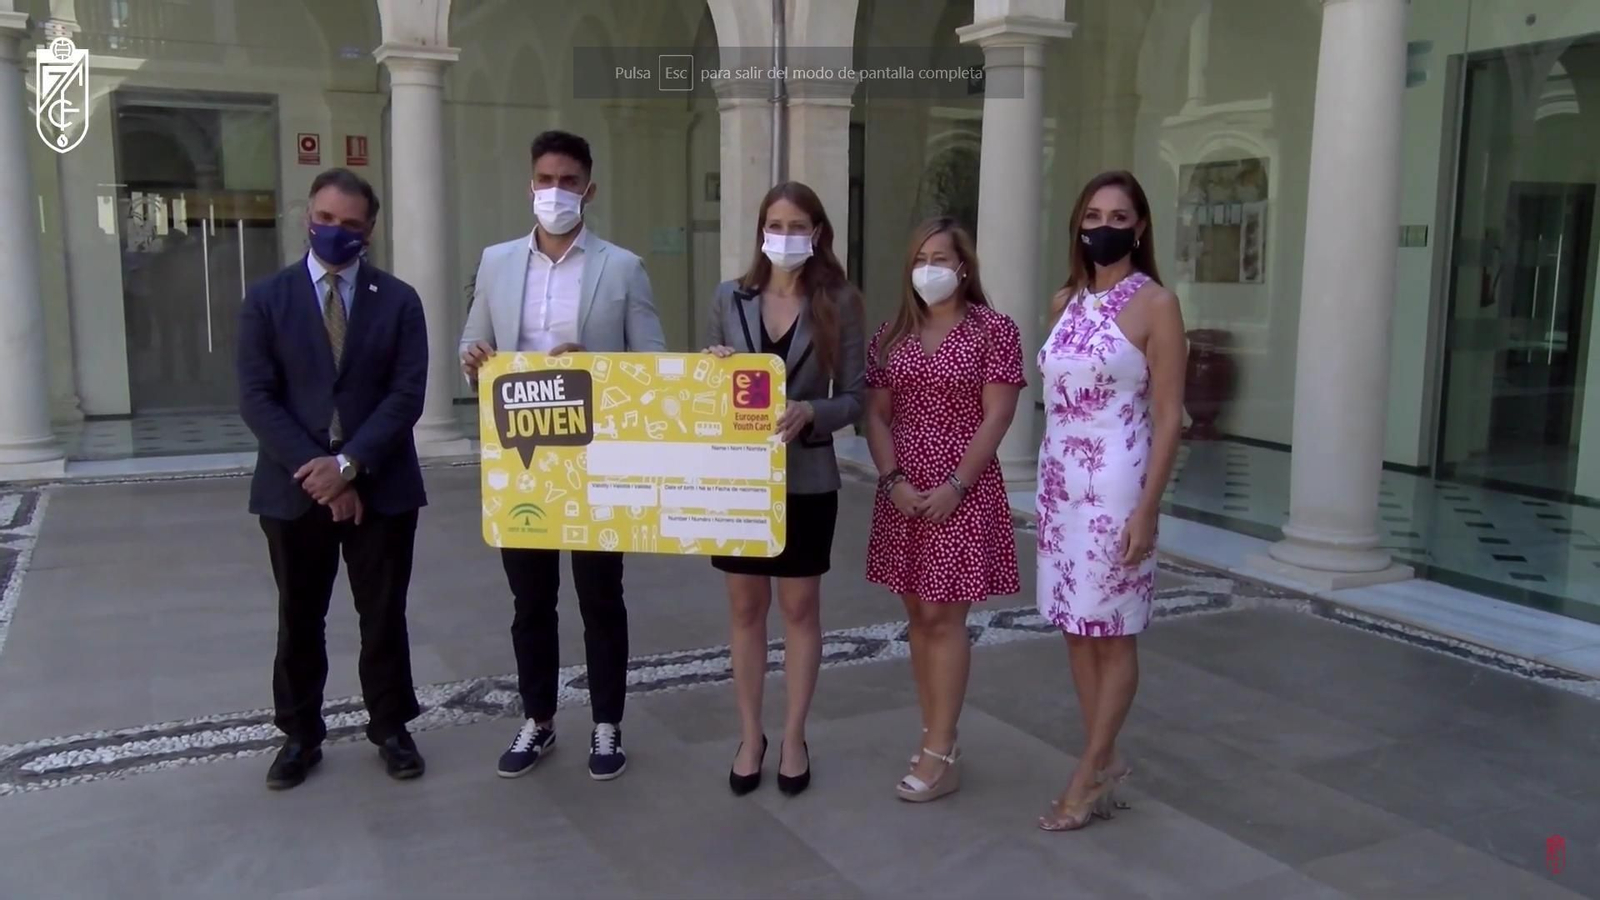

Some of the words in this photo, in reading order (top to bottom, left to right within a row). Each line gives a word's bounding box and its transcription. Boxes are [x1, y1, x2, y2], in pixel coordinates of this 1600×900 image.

[502, 375, 565, 404] CARNÉ
[506, 406, 586, 438] JOVEN
[733, 421, 754, 431] Youth
[755, 421, 772, 431] Card
[735, 412, 769, 422] European
